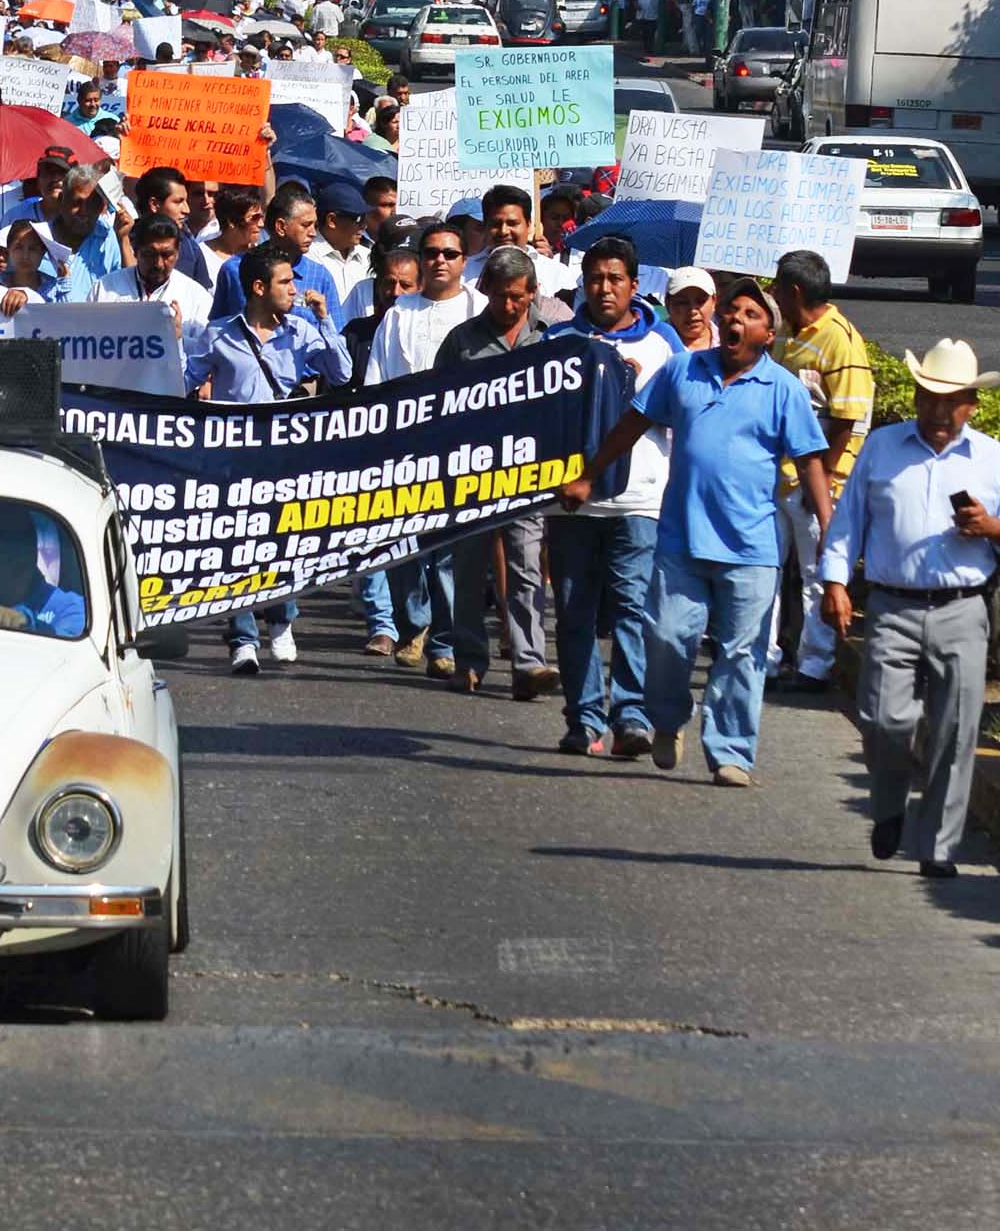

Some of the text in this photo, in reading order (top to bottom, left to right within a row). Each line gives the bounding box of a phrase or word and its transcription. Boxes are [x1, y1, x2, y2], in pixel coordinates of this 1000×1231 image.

[5, 60, 61, 74] gobernador
[475, 51, 576, 69] SR. GOBERNADOR
[203, 82, 259, 96] NECESIDAD
[460, 69, 590, 88] EL PERSONAL DEL AREA
[152, 98, 202, 112] MANTENER
[469, 89, 571, 106] DE SALUD LE
[147, 117, 180, 130] DOBLE
[185, 119, 216, 134] MORAL
[221, 123, 234, 135] EN
[478, 104, 581, 130] EXIGIMOS
[630, 115, 707, 139] DRA VESTA
[464, 131, 616, 154] SEGURIDAD A NUESTRO
[184, 158, 213, 174] NUEVA
[498, 151, 560, 169] GREMIO
[629, 143, 704, 167] YA BASTA
[756, 151, 789, 172] DRA
[800, 154, 850, 176] VESTA
[400, 162, 423, 182] LOS
[712, 171, 788, 198] EXIGIMOS
[399, 190, 424, 206] DEL
[705, 196, 853, 225] CON LOS ACUERDOS
[702, 221, 842, 246] QUE PREGONA EL
[204, 416, 262, 448] DEL
[271, 404, 388, 446] ESTADO
[396, 394, 435, 430] DE
[441, 356, 583, 417] MORELOS
[184, 479, 219, 509] la
[227, 453, 440, 503] destitución
[447, 444, 493, 476] de
[502, 434, 536, 464] la
[276, 481, 445, 535] ADRIANA
[453, 454, 584, 506] PINEDA
[231, 539, 278, 567] de
[285, 534, 320, 558] la
[328, 514, 448, 550] región
[170, 578, 191, 596] y
[178, 570, 280, 605] ORTIZ
